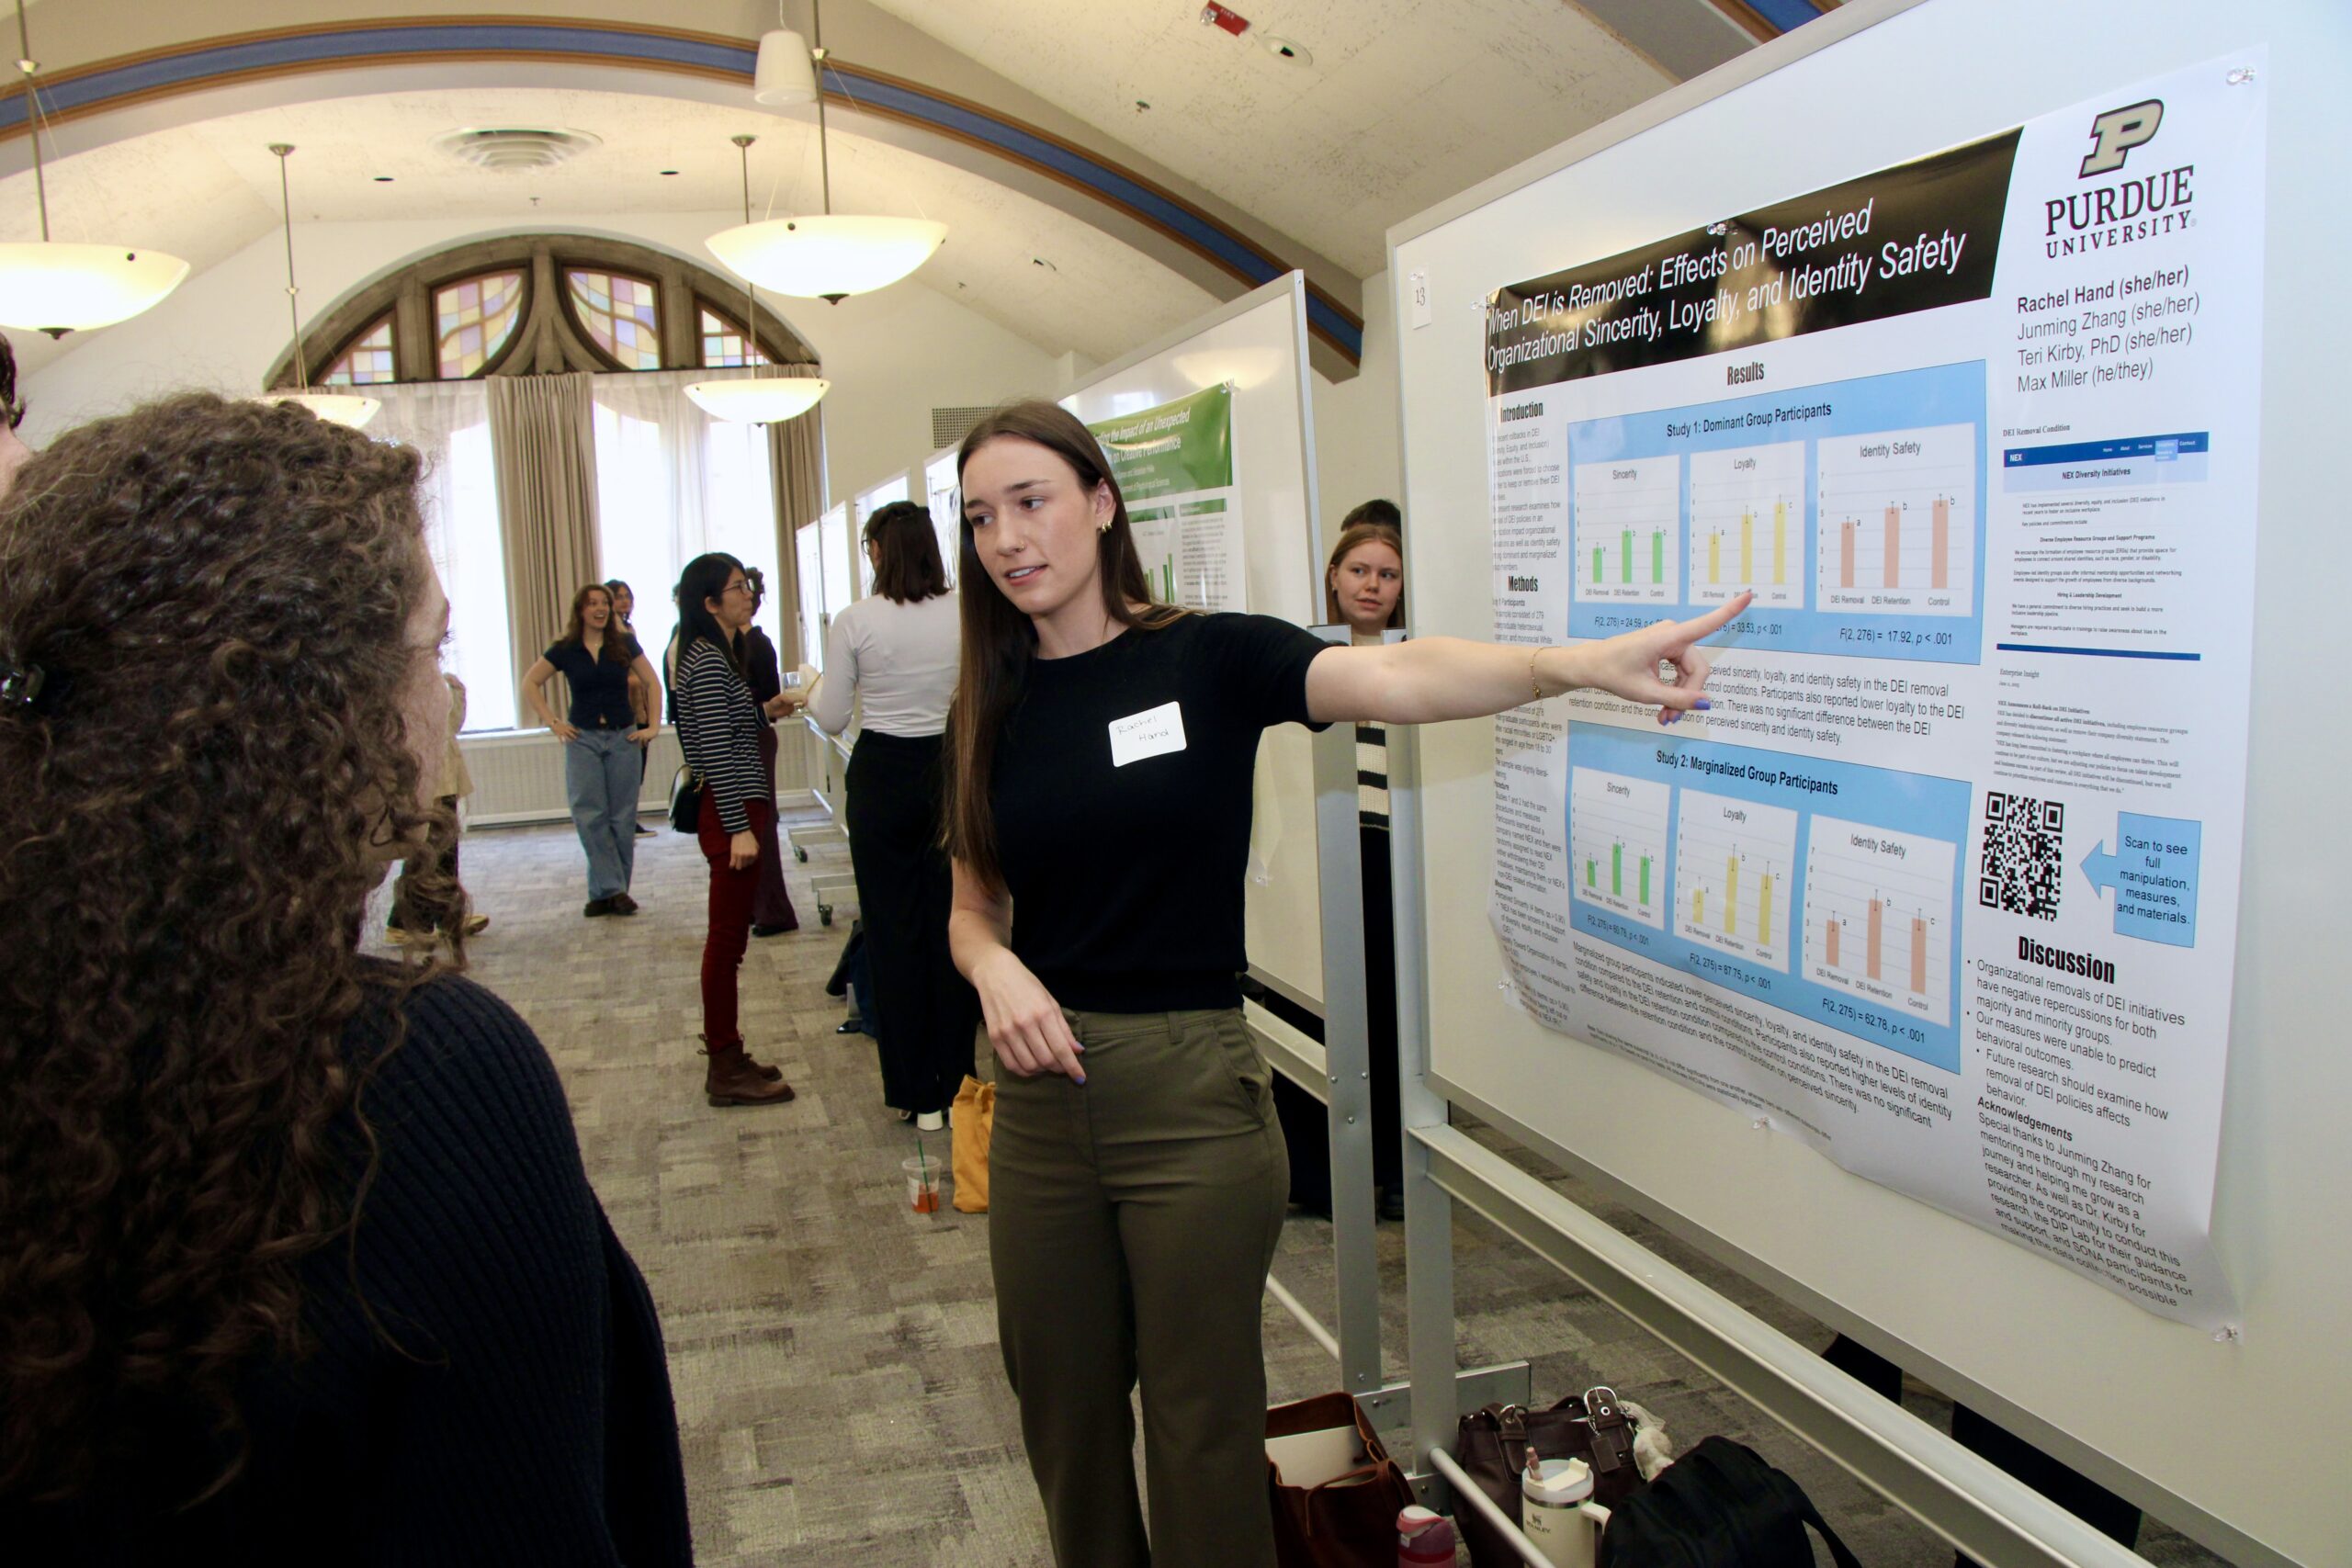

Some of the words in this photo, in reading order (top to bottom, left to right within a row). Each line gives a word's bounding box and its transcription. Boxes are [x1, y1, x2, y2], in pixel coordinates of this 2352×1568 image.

[2078, 99, 2164, 179] P
[2045, 164, 2194, 236] PURDUE
[2046, 209, 2192, 258] UNIVERSITY
[1489, 308, 1517, 335] When
[1522, 290, 1549, 325] DEI
[1552, 290, 1565, 316] is
[1568, 264, 1654, 312] Removed:
[1659, 247, 1727, 289] Effects
[1733, 242, 1755, 270] on
[1761, 197, 1874, 262] Perceived
[1416, 287, 1425, 306] 13
[1487, 323, 1580, 374] Organizational
[1584, 306, 1662, 347] Sincerity,
[1669, 288, 1739, 333] Loyalty,
[1747, 272, 1783, 312] and
[1790, 251, 1872, 300] Identity
[1880, 229, 1967, 278] Safety
[2018, 289, 2069, 314] Rachel
[2075, 281, 2114, 304] Hand
[2120, 265, 2189, 299] (she/her)
[2018, 316, 2077, 341] Junming
[2082, 308, 2126, 331] Zhang
[2132, 292, 2200, 322] (she/her)
[2018, 344, 2041, 367] Teri
[2048, 342, 2086, 364] Kirby,
[2091, 335, 2120, 355] PhD
[2125, 322, 2192, 355] (she/her)
[1727, 362, 1765, 386] Results
[2018, 375, 2046, 392] Max
[2052, 368, 2087, 389] Miller
[2091, 357, 2153, 387] (he/they)
[1500, 401, 1544, 423] Introduction
[1667, 423, 1690, 438] Study
[1693, 421, 1701, 434] 1:
[1703, 415, 1744, 433] Dominant
[1746, 412, 1772, 426] Group
[1775, 401, 1832, 423] Participants
[2003, 429, 2014, 437] DEI
[2017, 426, 2041, 435] Removal
[2042, 423, 2070, 434] Condition
[1735, 457, 1757, 471] Loyalty
[1860, 446, 1890, 458] Identity
[1893, 442, 1921, 456] Safety
[1612, 468, 1637, 481] Sincerity
[2063, 471, 2074, 479] NEX
[2075, 468, 2100, 479] Diversity
[2102, 468, 2131, 477] Initiatives
[1509, 576, 1538, 592] Methods
[1840, 627, 1854, 641] F(2,
[1857, 628, 1875, 642] 276)
[1889, 630, 1914, 644] 17.92,
[1933, 632, 1952, 645] .001
[1733, 667, 1761, 682] sincerity,
[1764, 669, 1788, 684] loyalty,
[1790, 671, 1804, 683] and
[1806, 672, 1834, 689] identity
[1837, 675, 1861, 691] safety
[1863, 676, 1871, 689] in
[1873, 678, 1887, 692] the
[1891, 679, 1907, 693] DEI
[1910, 682, 1949, 697] removal
[2000, 669, 2022, 678] Enterprise
[2024, 670, 2040, 679] Insight
[1761, 686, 1804, 704] Participants
[1805, 691, 1823, 704] also
[1824, 693, 1858, 710] reported
[1860, 696, 1883, 711] lower
[1886, 698, 1915, 716] loyalty
[1918, 701, 1927, 715] to
[1929, 703, 1945, 717] the
[1947, 705, 1964, 719] DEI
[1657, 750, 1679, 769] Study
[1680, 754, 1689, 768] 2:
[1690, 756, 1746, 778] Marginalized
[1747, 766, 1777, 785] Group
[1779, 771, 1838, 795] Participants
[1607, 782, 1631, 798] Sincerity
[1724, 807, 1747, 823] Loyalty
[1850, 833, 1878, 852] Identity
[1881, 840, 1906, 860] Safety
[2125, 836, 2150, 851] Scan
[2153, 840, 2163, 852] to
[2165, 842, 2188, 856] see
[2145, 855, 2161, 869] full
[2120, 869, 2190, 892] manipulation,
[2125, 887, 2180, 908] measures,
[2117, 903, 2134, 916] and
[2137, 905, 2190, 925] materials.
[2018, 936, 2115, 984] Discussion
[1816, 967, 1826, 978] DEI
[1826, 969, 1849, 985] Removal
[1856, 980, 1865, 990] DEI
[1867, 983, 1893, 999] Retention
[1907, 998, 1928, 1011] Control
[1977, 959, 2043, 987] Organizational
[2047, 980, 2090, 1001] removals
[2094, 992, 2104, 1004] of
[2107, 995, 2125, 1010] DEI
[2129, 1000, 2185, 1025] initiatives
[1977, 976, 1998, 992] have
[2001, 986, 2040, 1004] negative
[2043, 997, 2112, 1027] repercussions
[2115, 1016, 2129, 1031] for
[2132, 1021, 2156, 1039] both
[1823, 998, 1837, 1013] F(2,
[1838, 1003, 1856, 1021] 275)
[1865, 1012, 1890, 1032] 62.78,
[1907, 1027, 1925, 1043] .001
[1977, 996, 2012, 1016] majority
[2015, 1008, 2031, 1020] and
[2035, 1013, 2073, 1035] minority
[2075, 1026, 2112, 1045] groups.
[1977, 1011, 1994, 1025] Our
[1996, 1019, 2041, 1041] measures
[2044, 1033, 2066, 1049] were
[2070, 1043, 2103, 1061] unable
[2107, 1052, 2116, 1065] to
[2120, 1058, 2156, 1078] predict
[1977, 1028, 2021, 1053] behavioral
[2025, 1046, 2074, 1070] outcomes.
[1986, 1048, 2016, 1068] Future
[2018, 1061, 2059, 1083] research
[2062, 1077, 2095, 1096] should
[2098, 1088, 2142, 1111] examine
[2145, 1102, 2168, 1120] how
[1986, 1083, 2027, 1107] behavior.
[1986, 1067, 2022, 1088] removal
[2025, 1080, 2033, 1091] of
[2037, 1083, 2053, 1100] DEI
[2056, 1090, 2094, 1114] policies
[2097, 1106, 2131, 1127] affects
[1977, 1096, 2073, 1142] Acknowledgements
[1979, 1112, 2011, 1134] Special
[2013, 1124, 2043, 1147] thanks
[2046, 1138, 2054, 1152] to
[2057, 1144, 2098, 1171] Junming
[2101, 1159, 2133, 1186] Zhang
[2137, 1174, 2151, 1190] for
[2073, 1241, 2103, 1262] SONA
[2106, 1258, 2173, 1291] participants
